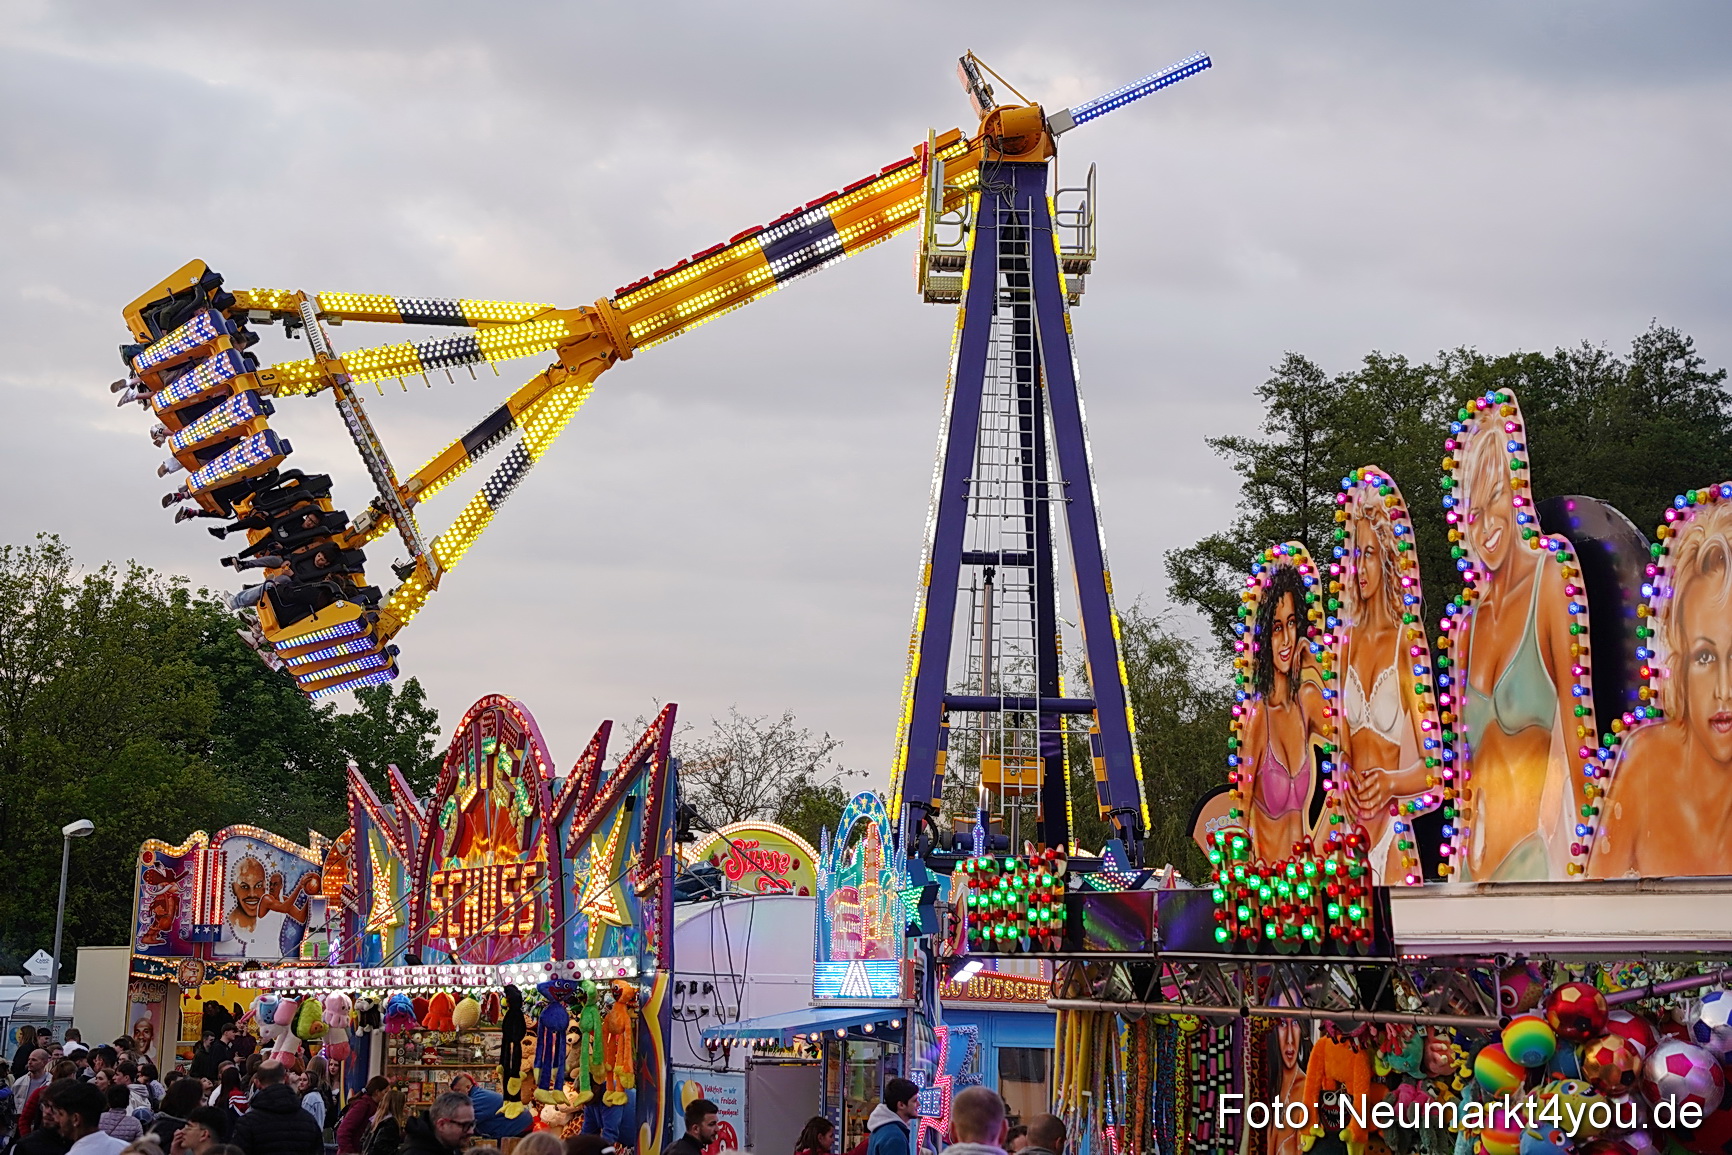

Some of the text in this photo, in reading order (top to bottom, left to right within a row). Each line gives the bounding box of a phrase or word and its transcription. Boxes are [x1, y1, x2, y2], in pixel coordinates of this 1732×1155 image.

[429, 863, 541, 939] SCHUSS
[129, 980, 167, 995] MAGIC
[966, 975, 1052, 1000] RUTSCHE
